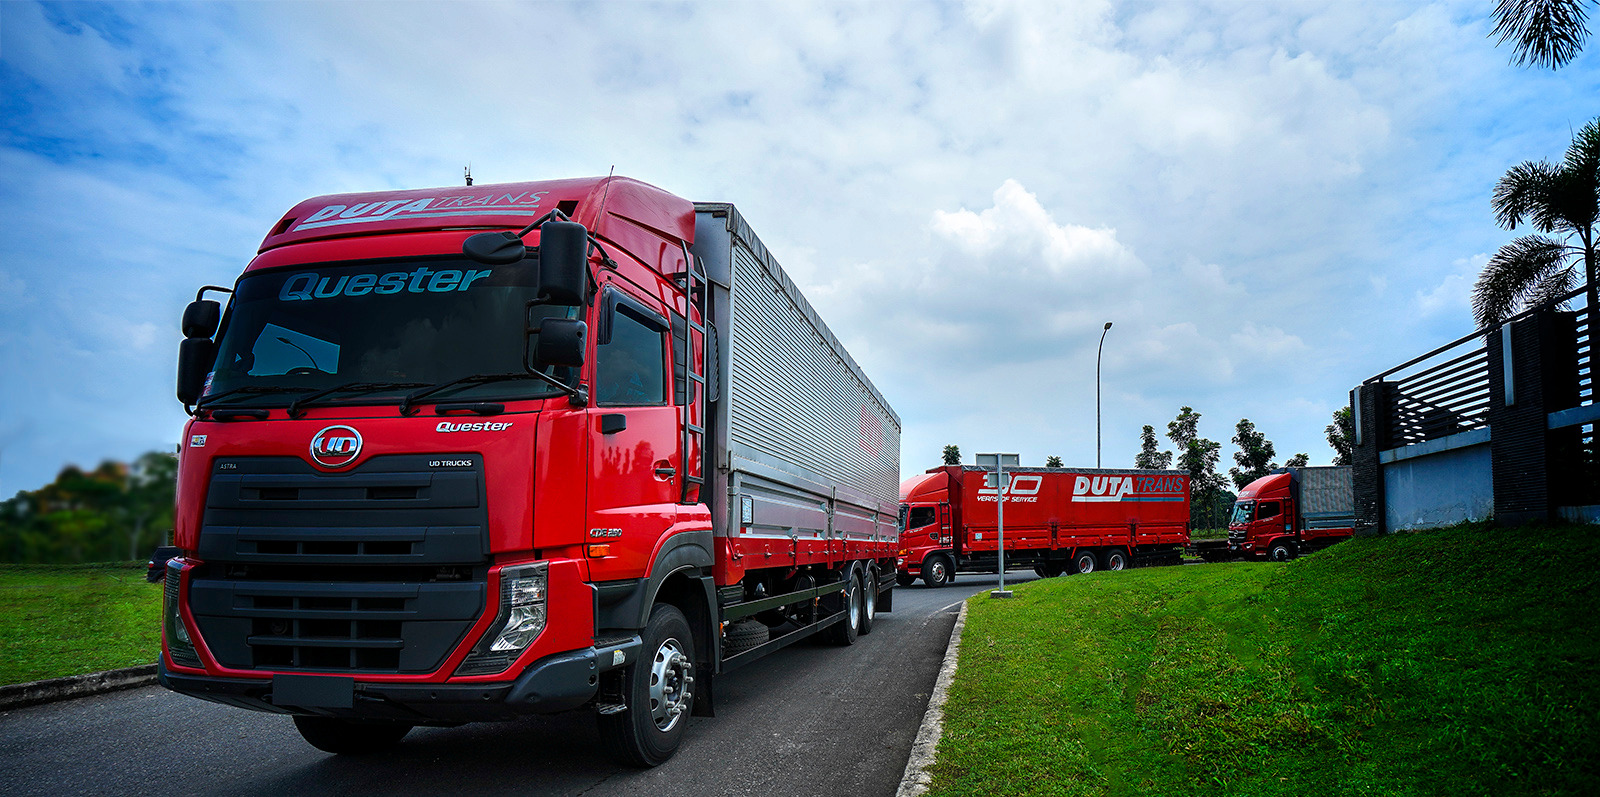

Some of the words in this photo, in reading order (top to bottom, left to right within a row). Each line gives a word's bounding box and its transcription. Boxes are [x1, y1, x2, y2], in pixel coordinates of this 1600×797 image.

[302, 198, 435, 224] DUTA
[431, 191, 550, 209] TRANS
[279, 266, 492, 301] Quester
[436, 421, 514, 433] Quester
[314, 437, 358, 456] UD
[1072, 476, 1134, 496] DUTA
[1136, 477, 1184, 492] TRANS
[590, 528, 608, 538] CDE
